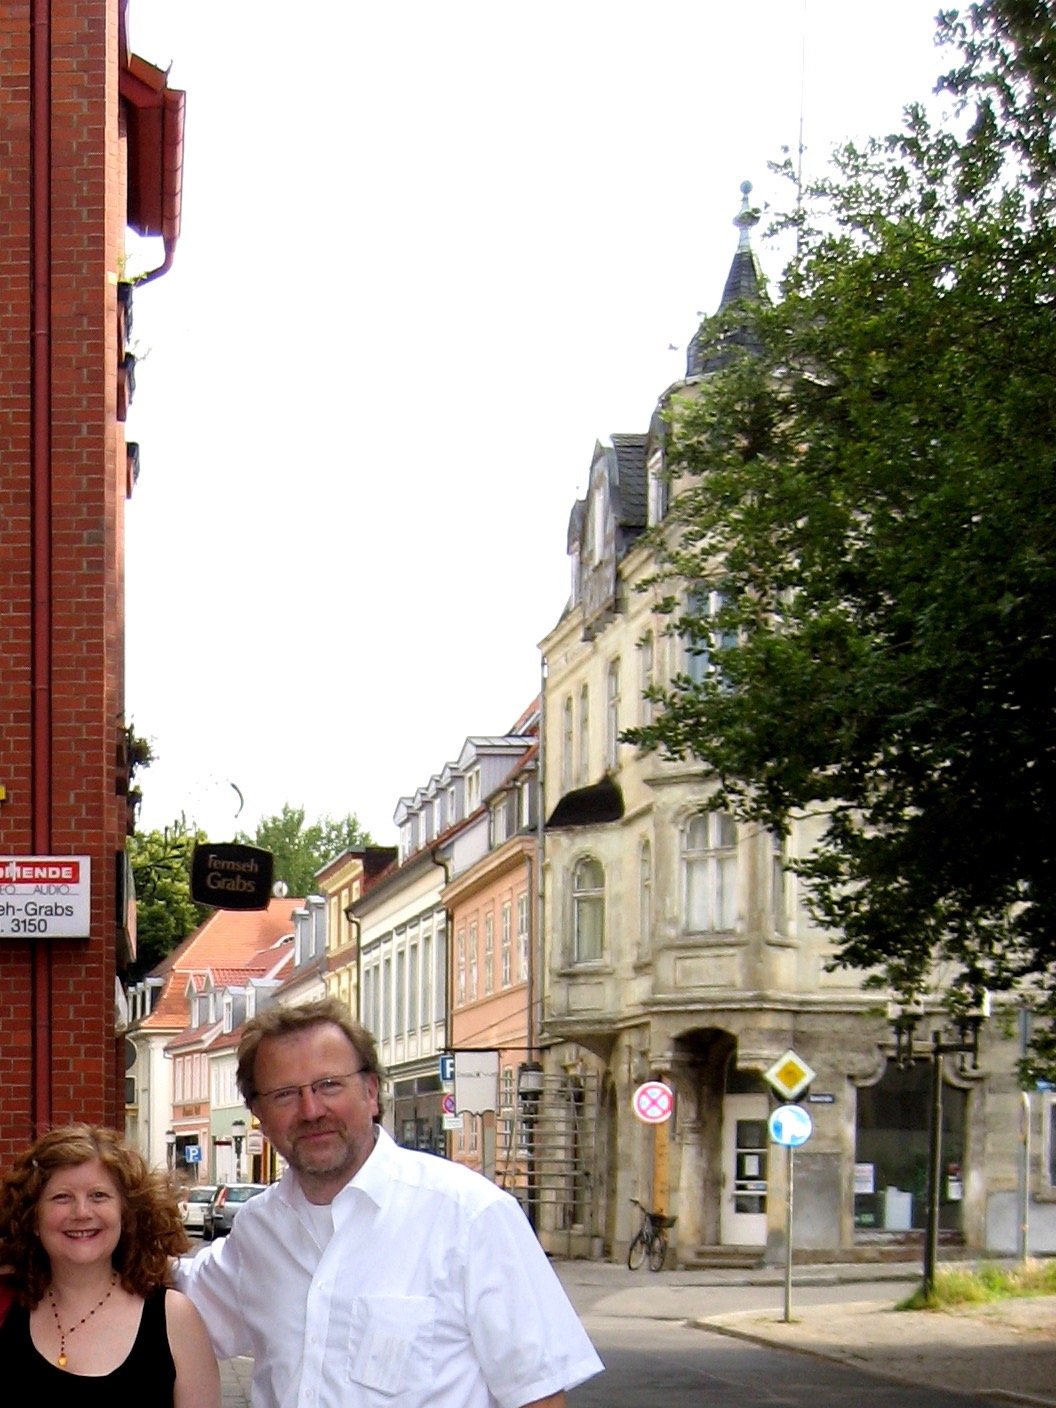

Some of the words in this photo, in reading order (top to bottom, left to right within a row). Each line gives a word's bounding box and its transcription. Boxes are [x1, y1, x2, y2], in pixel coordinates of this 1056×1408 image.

[207, 854, 259, 872] Fernseh
[206, 871, 256, 892] Grabs
[33, 884, 70, 896] AUDIO
[11, 918, 48, 933] 3150
